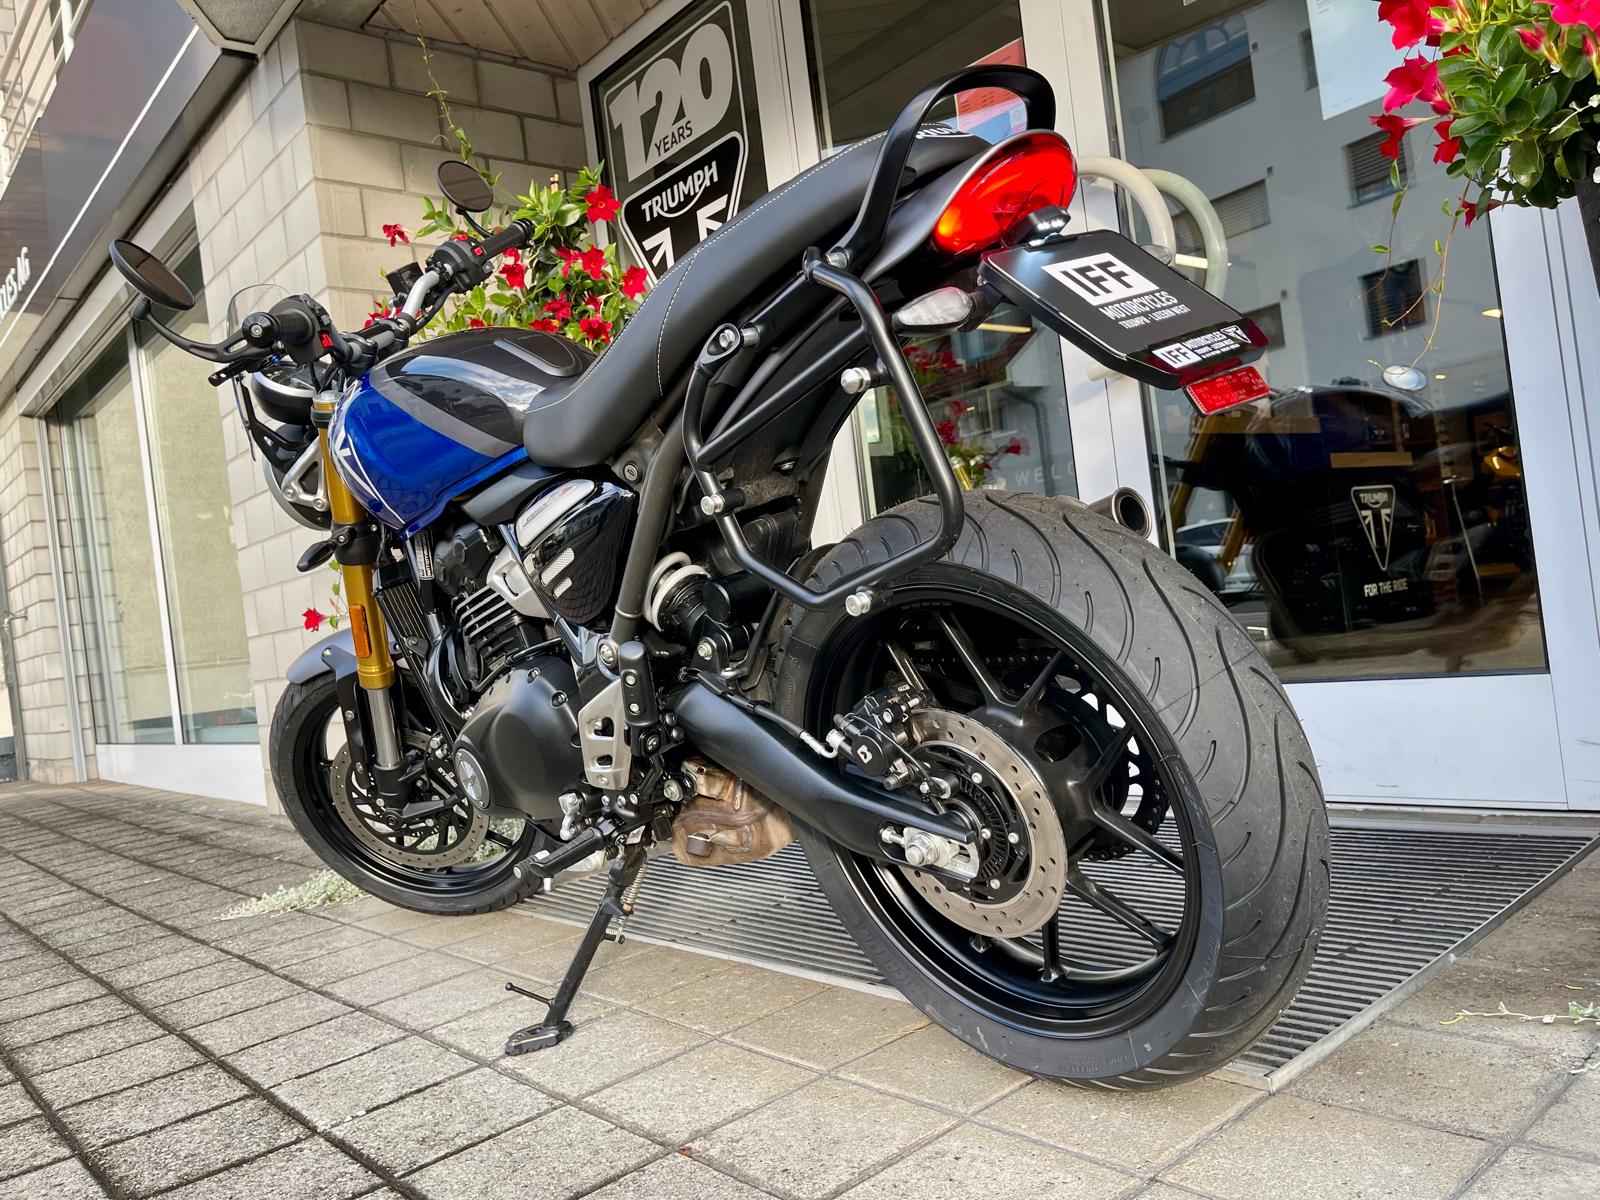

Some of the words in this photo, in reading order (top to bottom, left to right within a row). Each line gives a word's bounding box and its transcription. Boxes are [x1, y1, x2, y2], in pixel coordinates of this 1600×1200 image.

[609, 23, 733, 183] 120
[654, 120, 694, 157] YEARS
[641, 161, 719, 222] TRIUMPH
[1059, 260, 1133, 297] IFF
[1098, 291, 1178, 320] MOTORCYCLES
[1161, 346, 1191, 364] IFF
[1360, 492, 1388, 508] TRIUMPH
[1364, 583, 1379, 597] FOR
[1379, 581, 1392, 594] THE
